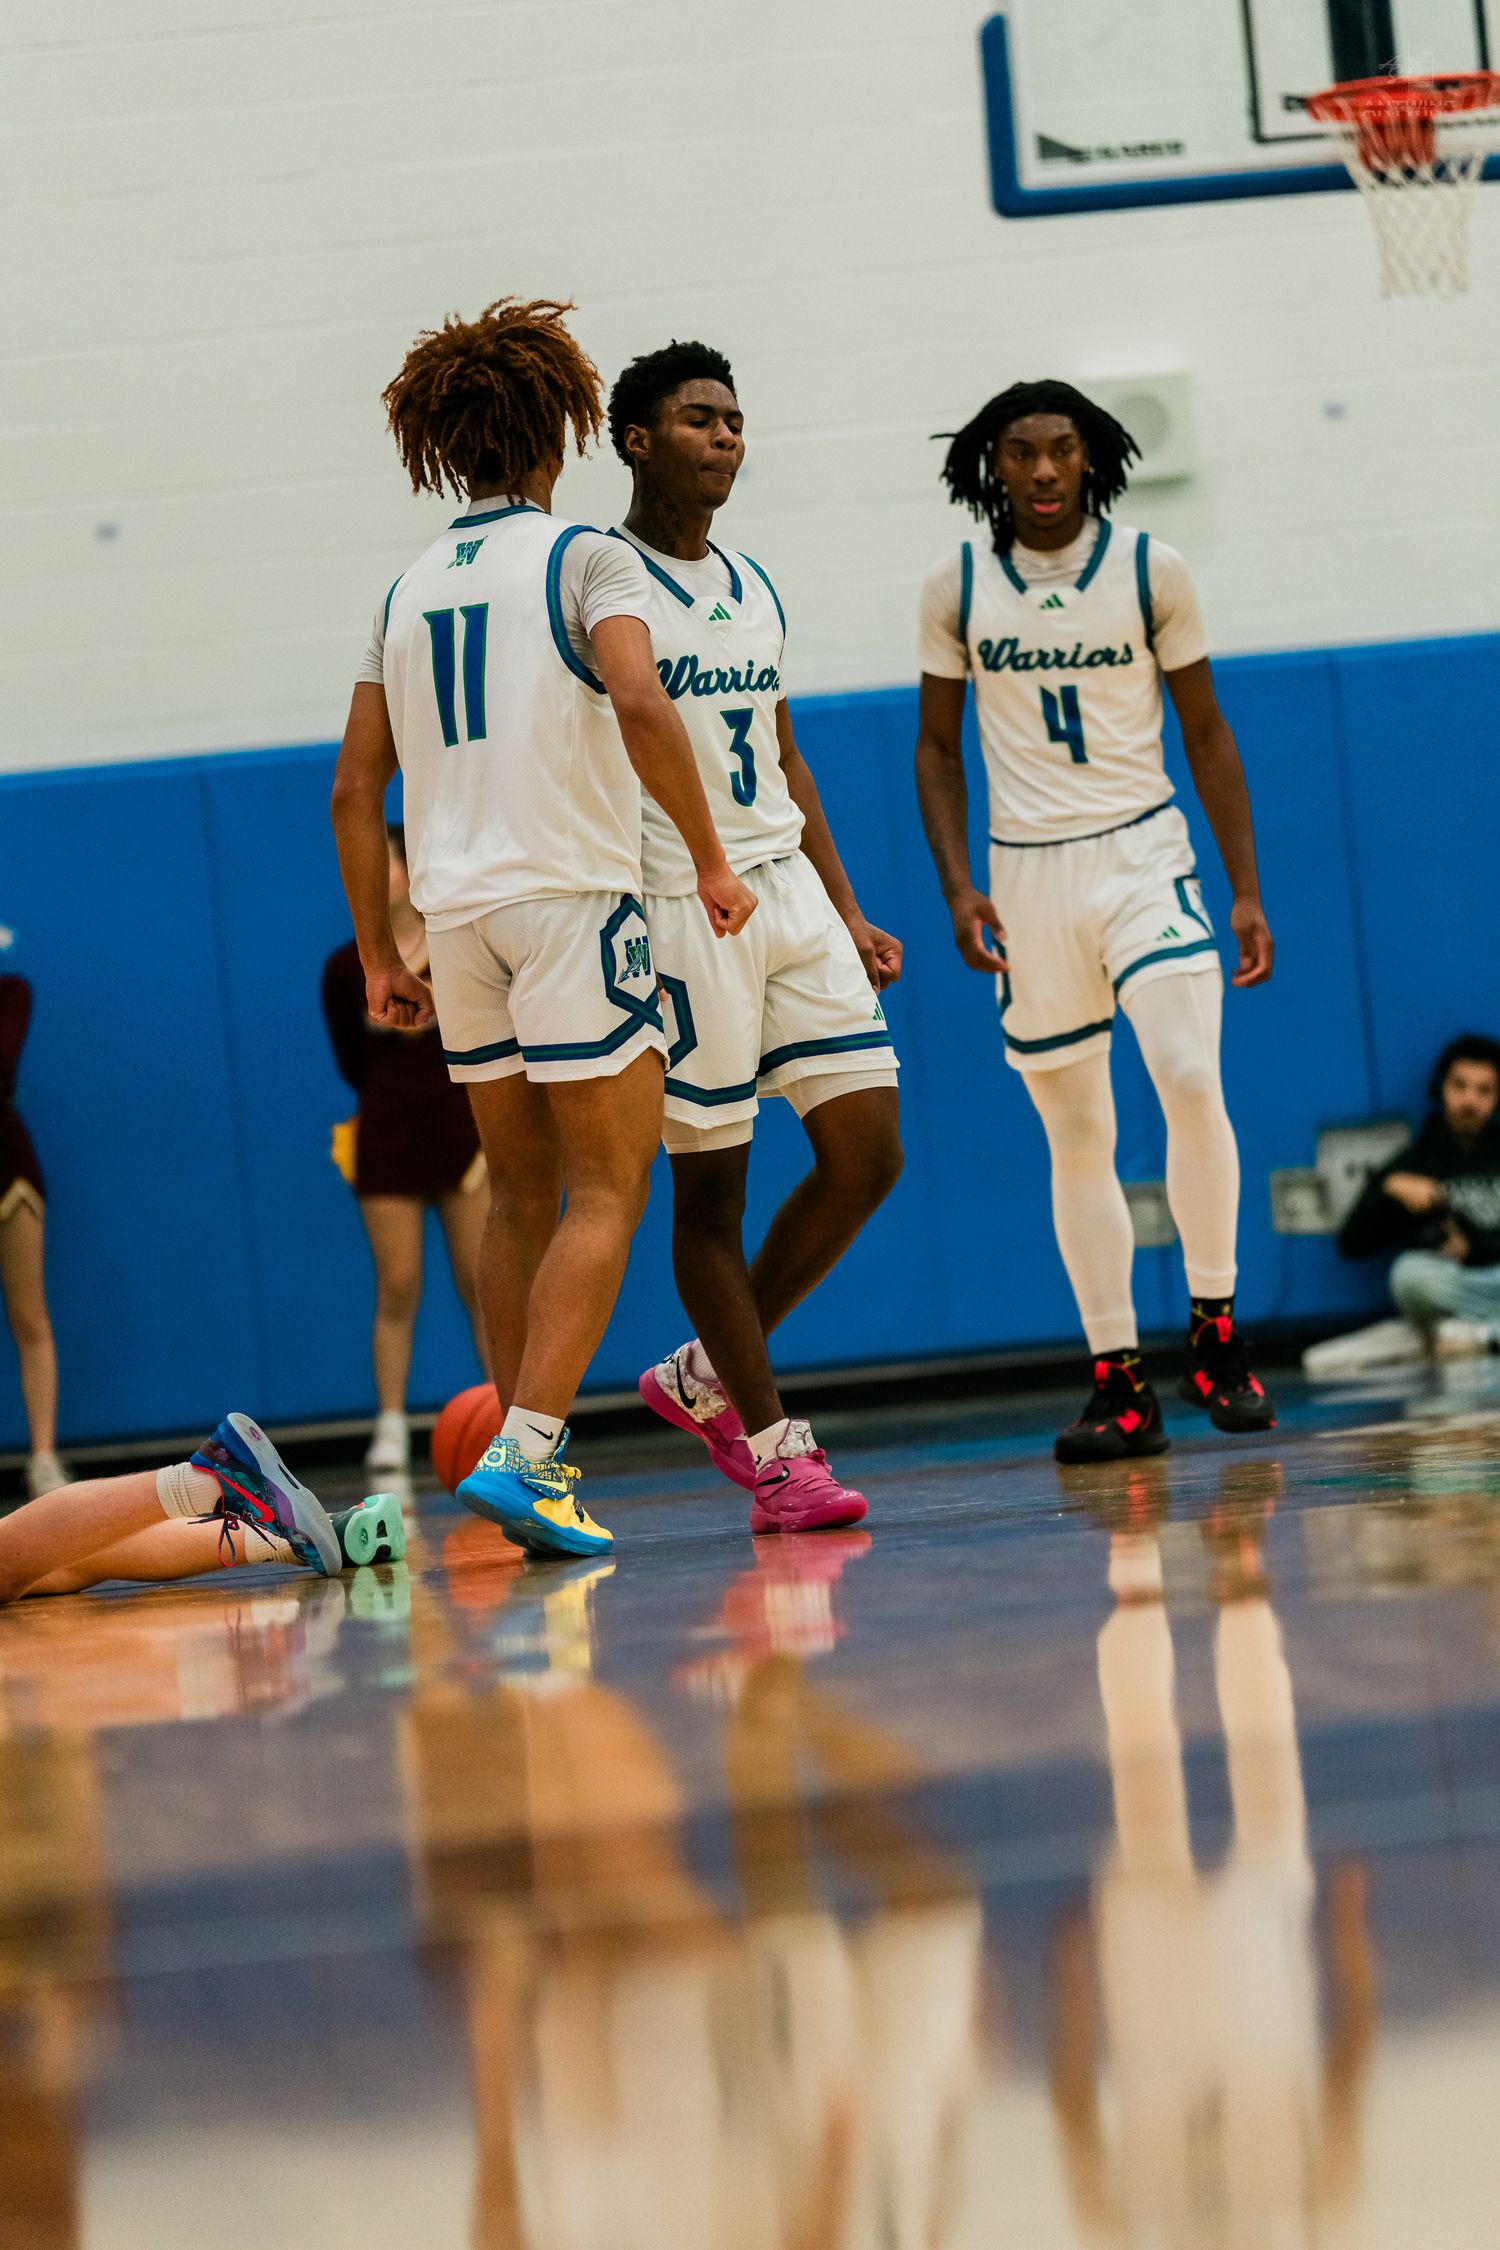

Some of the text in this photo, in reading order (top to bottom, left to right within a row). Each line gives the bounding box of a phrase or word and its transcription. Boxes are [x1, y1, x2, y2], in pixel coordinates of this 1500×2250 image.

[422, 602, 489, 747] 11
[978, 637, 1134, 672] Warriors
[719, 707, 757, 807] 3
[1039, 685, 1089, 764] 4
